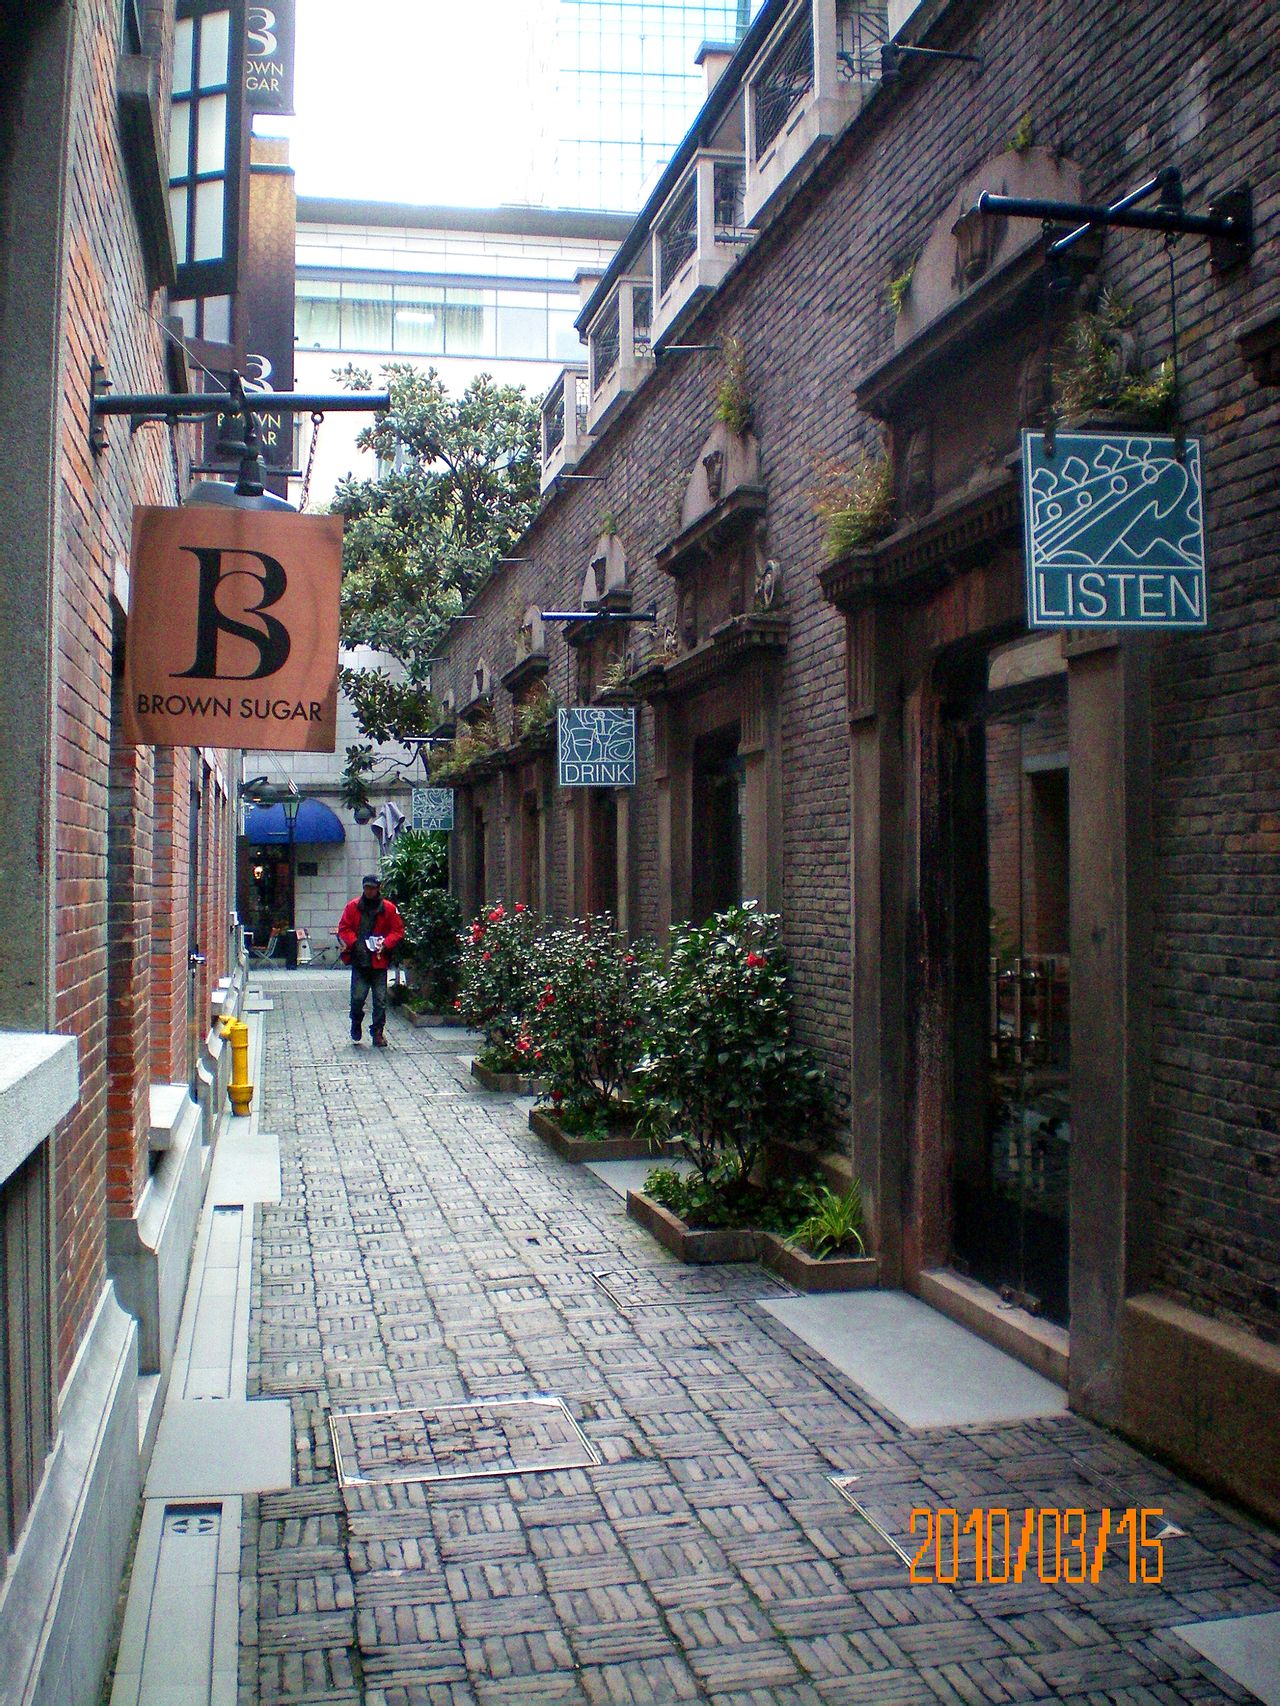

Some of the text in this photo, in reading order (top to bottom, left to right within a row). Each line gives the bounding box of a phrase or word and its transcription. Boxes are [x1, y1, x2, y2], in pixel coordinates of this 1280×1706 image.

[1038, 572, 1201, 618] LISTEN
[137, 694, 322, 722] BROWN SUGAR
[565, 763, 632, 783] DRINK
[421, 818, 444, 829] EAT
